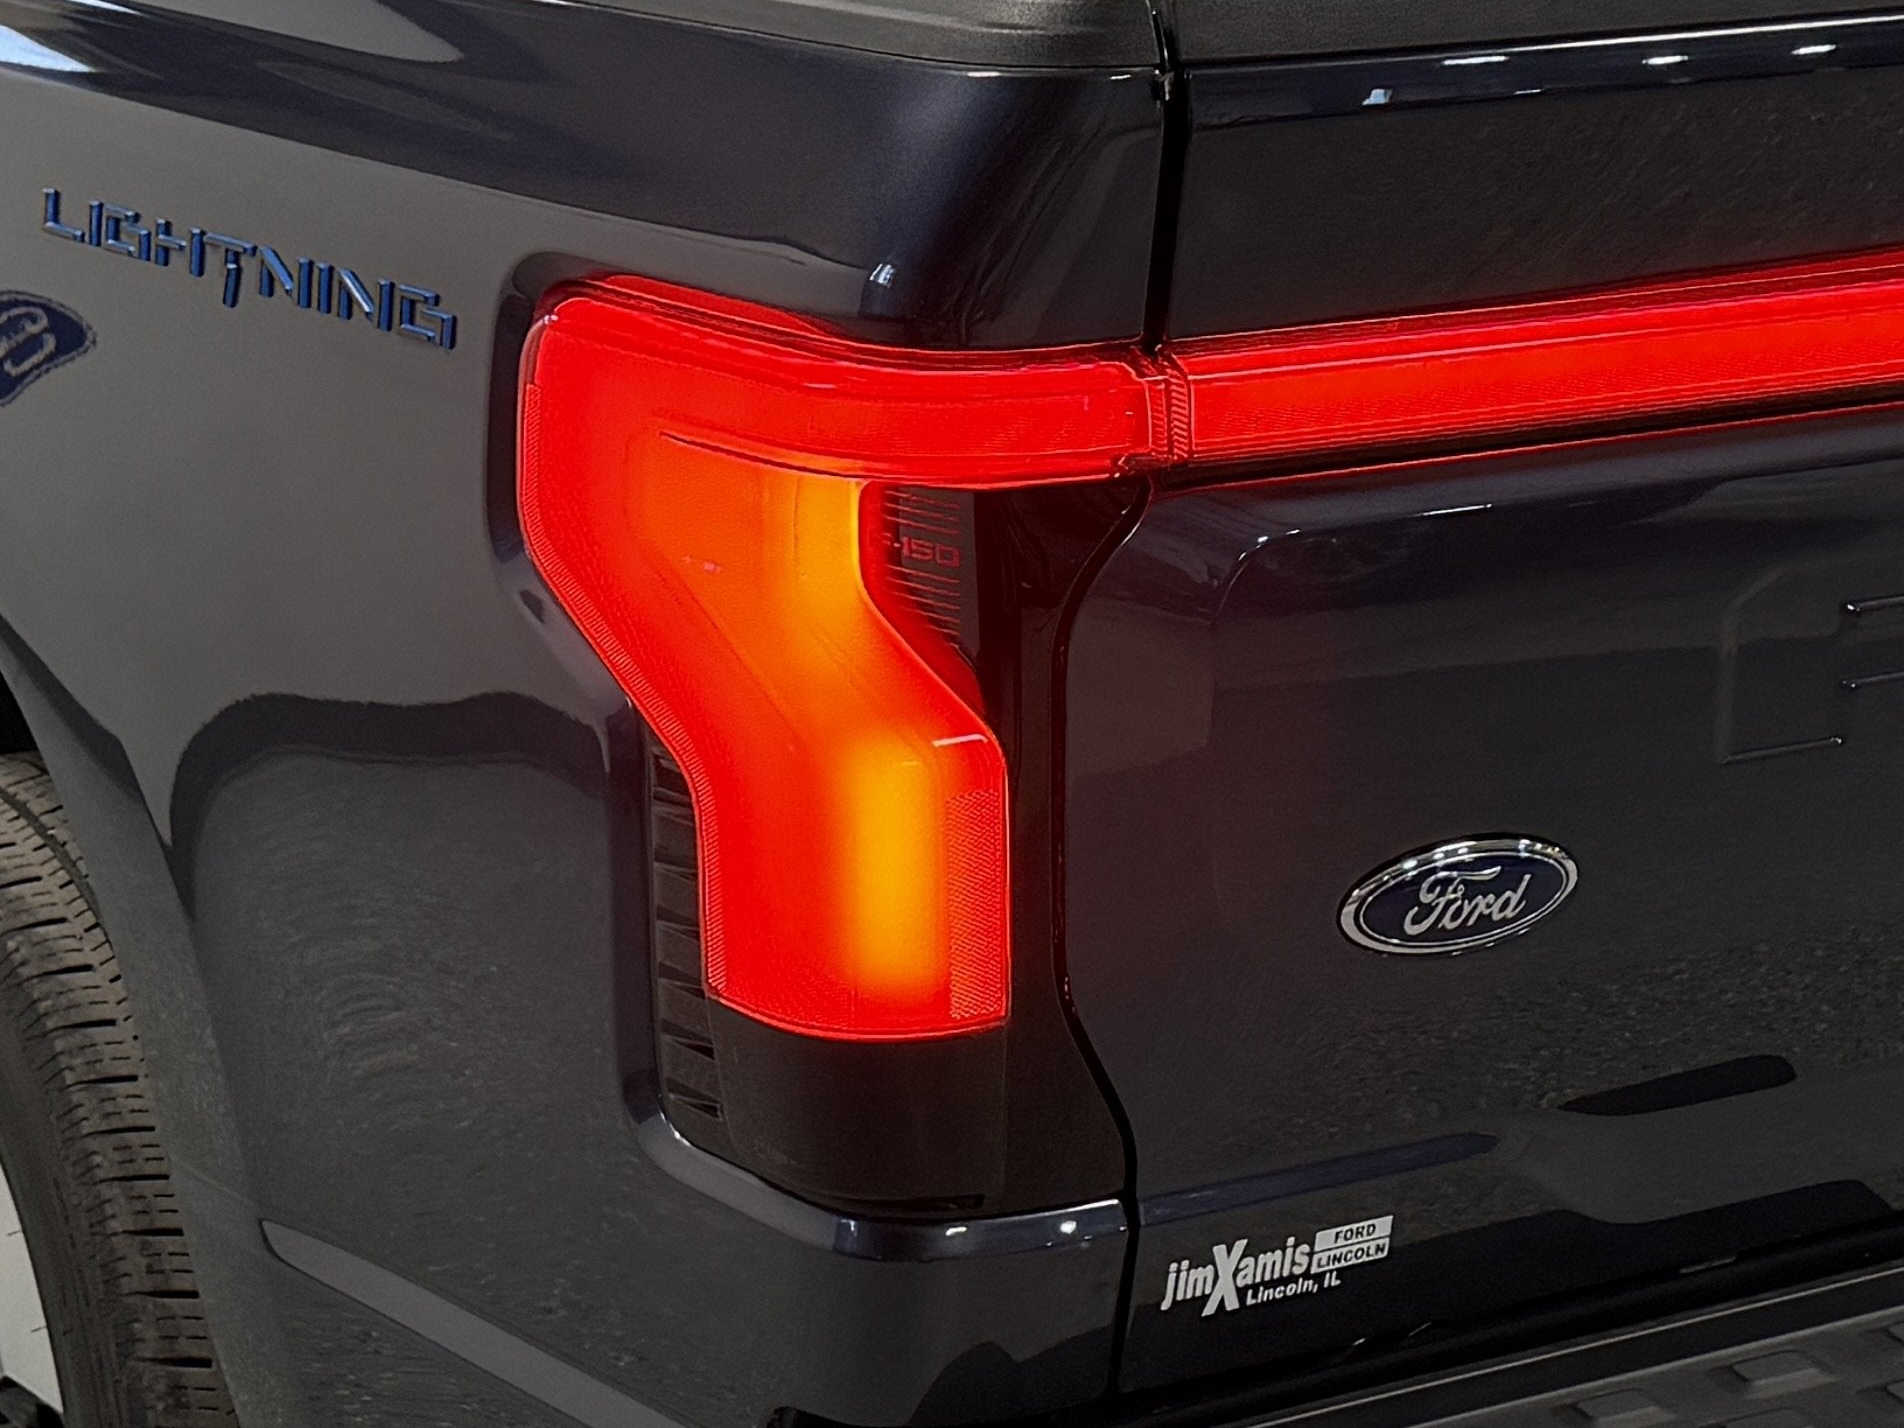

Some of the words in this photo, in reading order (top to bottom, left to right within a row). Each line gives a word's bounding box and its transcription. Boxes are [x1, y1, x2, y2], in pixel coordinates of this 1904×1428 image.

[42, 188, 457, 349] LIGHTNING
[1402, 865, 1532, 936] Ford
[1316, 1242, 1387, 1270] LINCOLN
[1334, 1222, 1377, 1245] FORD
[1160, 1236, 1312, 1317] jimXamis
[1246, 1276, 1318, 1307] Lincoln,
[1323, 1270, 1342, 1289] IL
